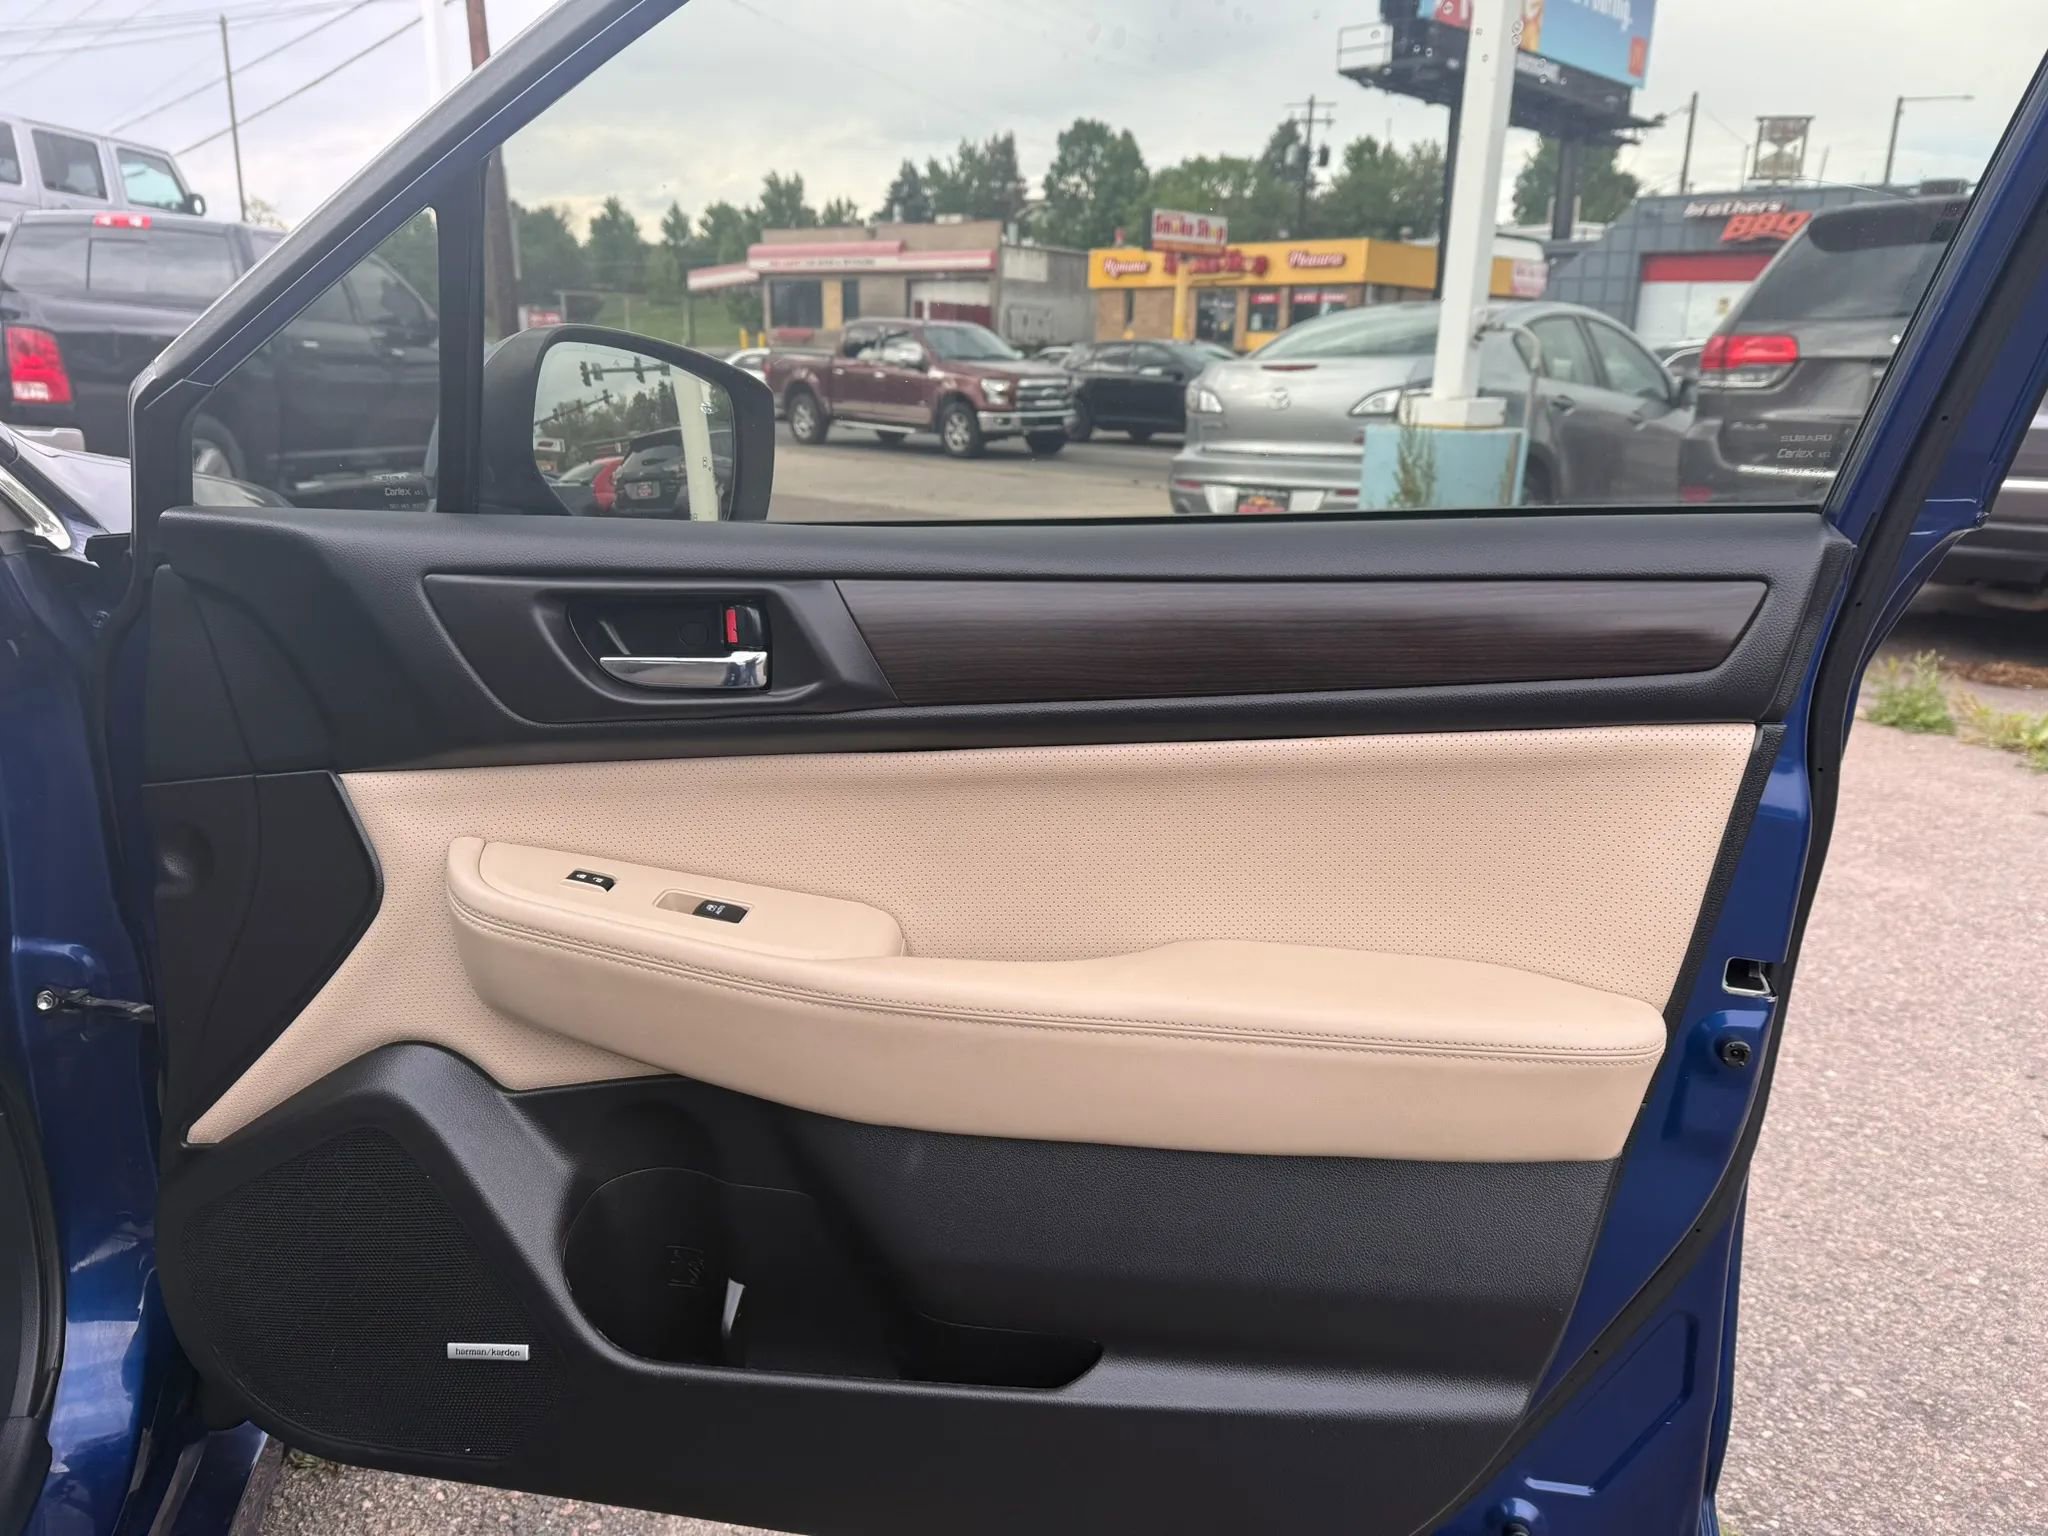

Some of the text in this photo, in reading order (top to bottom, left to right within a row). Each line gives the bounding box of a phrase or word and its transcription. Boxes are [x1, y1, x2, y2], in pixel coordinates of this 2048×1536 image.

[1683, 201, 1782, 217] brothers
[1721, 211, 1812, 240] BBQ
[1780, 433, 1833, 442] SUBARU
[455, 1347, 521, 1357] harman/kardon
